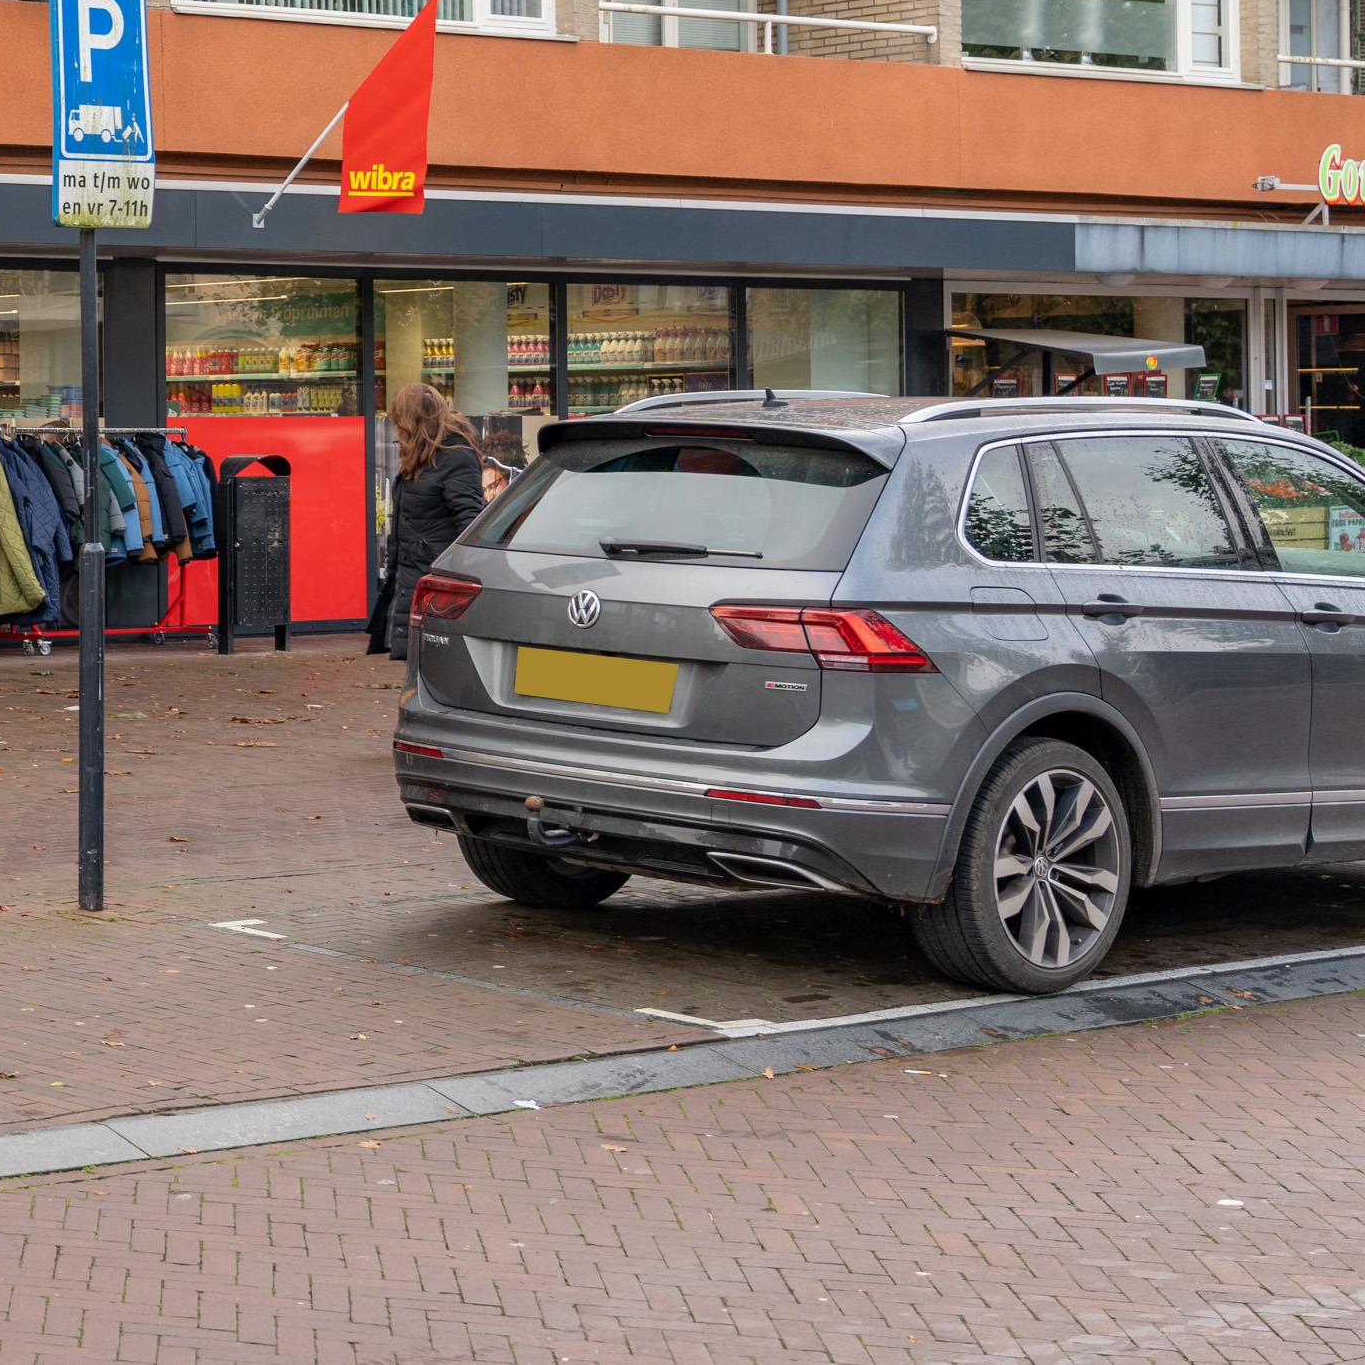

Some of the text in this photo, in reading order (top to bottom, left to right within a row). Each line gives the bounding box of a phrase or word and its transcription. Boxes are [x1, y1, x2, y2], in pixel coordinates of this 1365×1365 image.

[63, 171, 150, 193] ma t/m wo
[349, 164, 416, 191] wibra
[62, 199, 149, 217] en vr 7-11h
